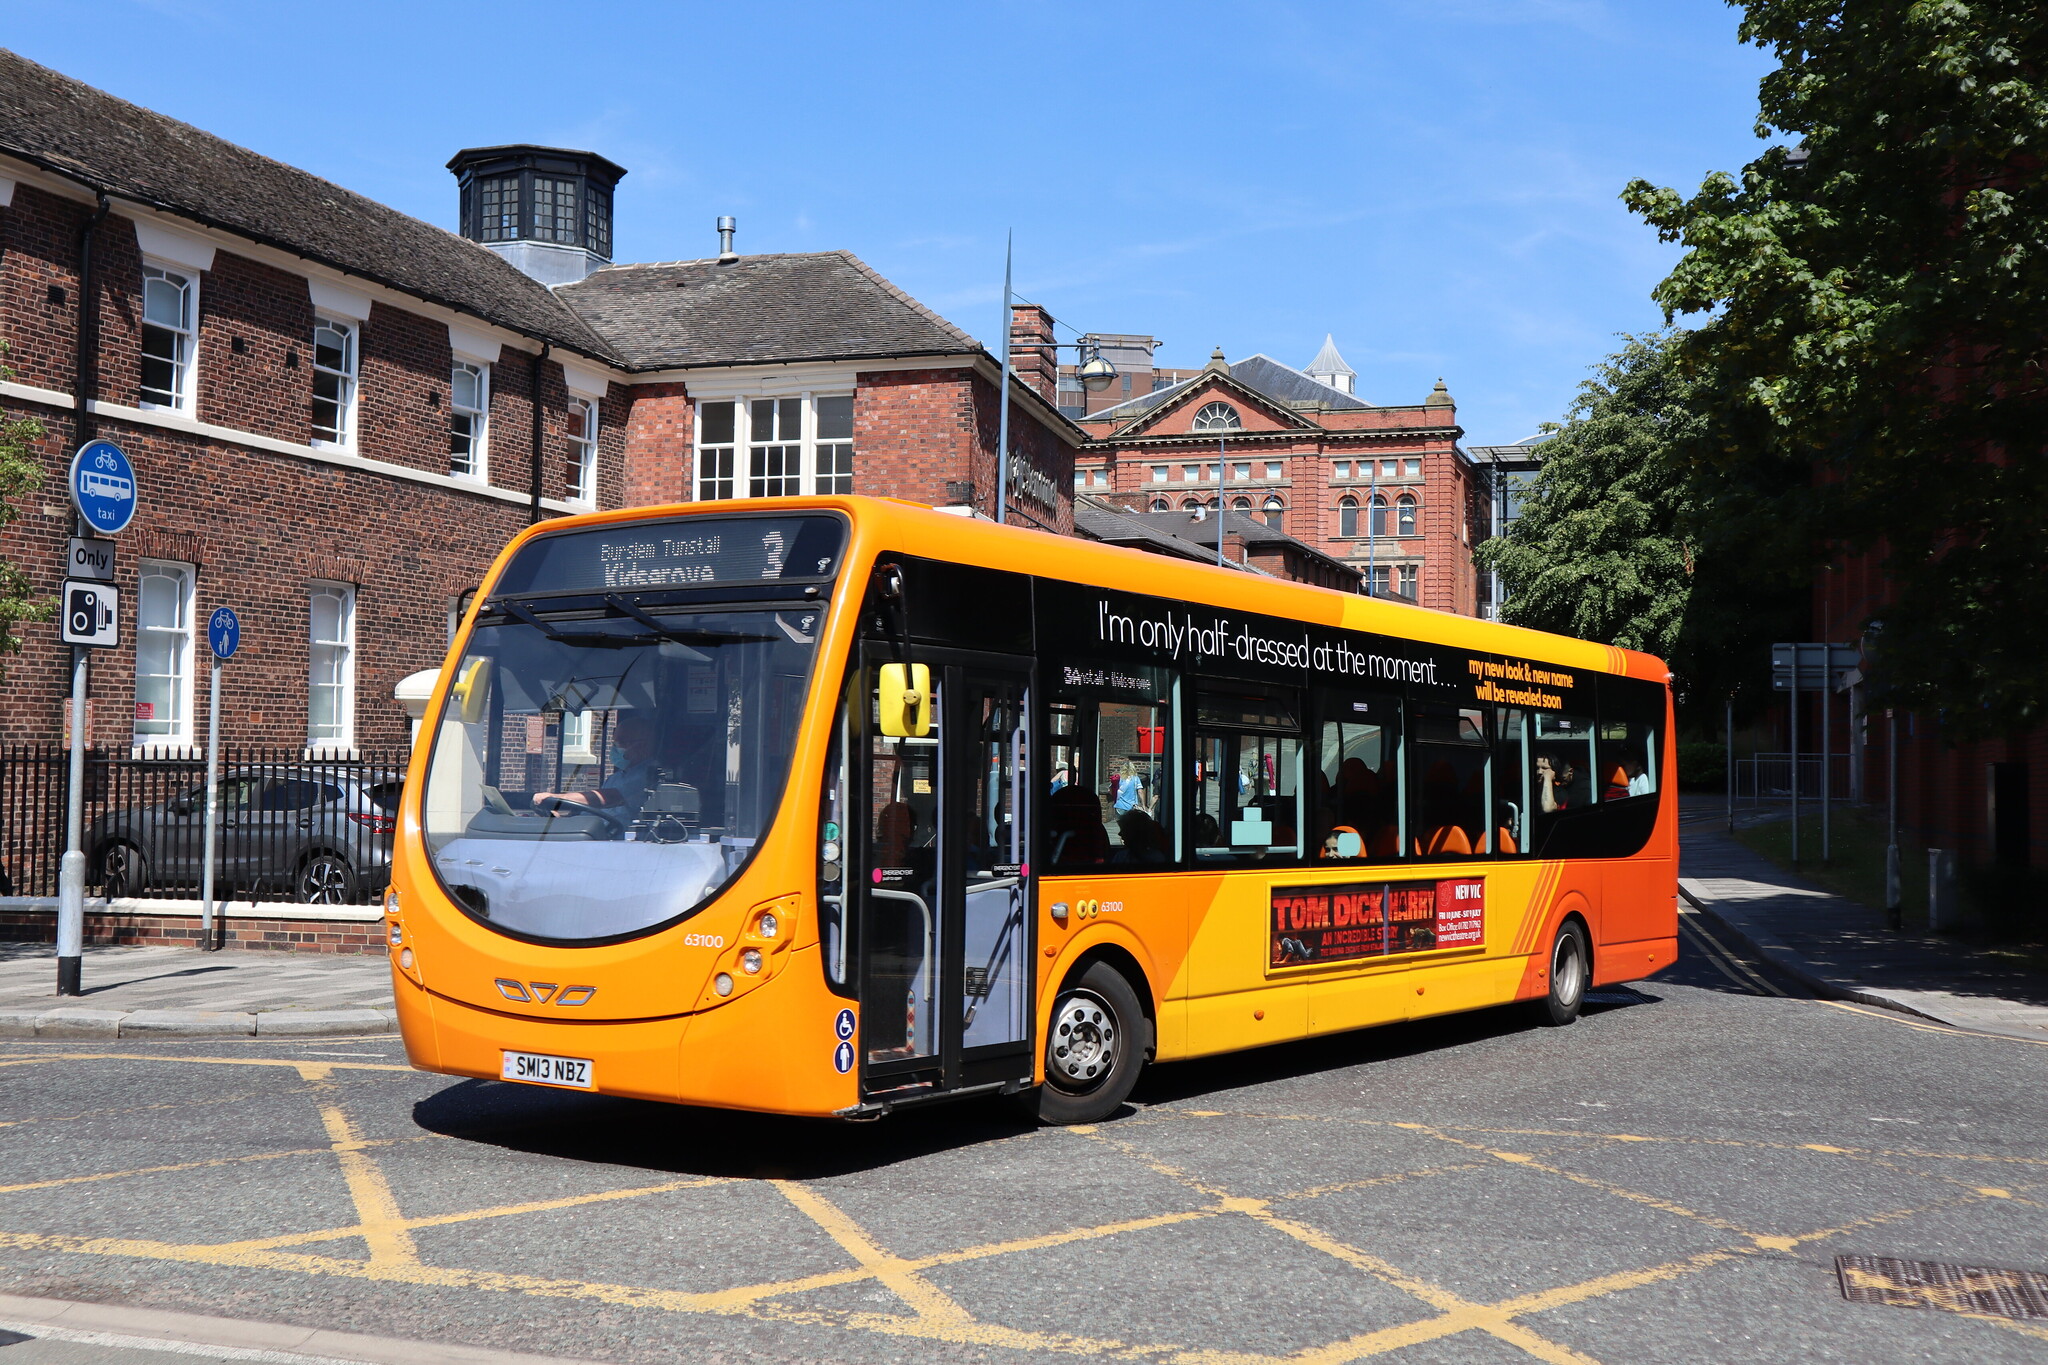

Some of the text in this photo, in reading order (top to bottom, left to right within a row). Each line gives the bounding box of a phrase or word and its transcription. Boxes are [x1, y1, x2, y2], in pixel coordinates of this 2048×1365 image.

[98, 507, 115, 520] taxi
[76, 548, 108, 570] Only
[601, 536, 720, 561] Burslem Tunstall
[605, 562, 714, 587] Kidsgrove
[1100, 601, 1135, 644] I'm
[1140, 611, 1184, 660] only
[1188, 614, 1310, 669] half-dressed
[1314, 642, 1335, 672] at
[1336, 640, 1366, 676] the
[1468, 659, 1573, 688] my new look & new name
[1475, 680, 1562, 709] will be revealed soon
[1456, 885, 1469, 899] NEW
[1470, 884, 1481, 899] VIC
[1101, 901, 1123, 912] 63100
[1387, 890, 1435, 922] HARRY
[684, 934, 723, 948] 63100
[1321, 932, 1333, 946] AN
[1334, 927, 1375, 944] INCREDIBLE
[517, 1056, 586, 1082] SM13 NBZ
